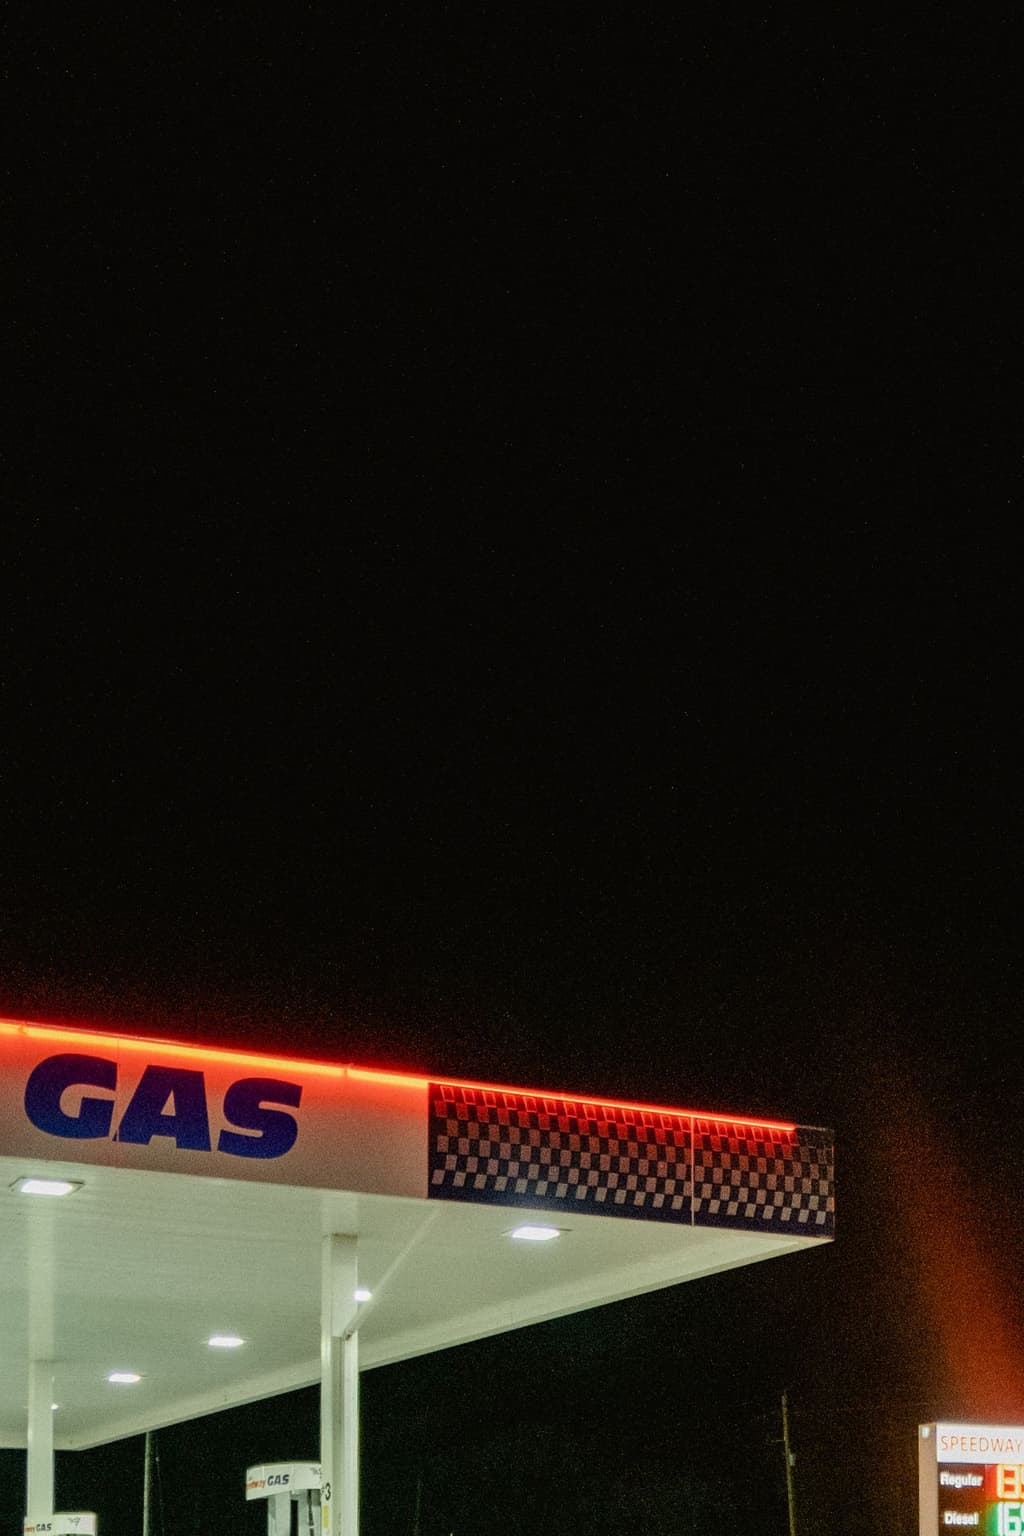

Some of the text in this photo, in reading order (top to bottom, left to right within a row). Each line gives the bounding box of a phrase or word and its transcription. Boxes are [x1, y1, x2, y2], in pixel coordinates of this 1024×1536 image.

[24, 1053, 303, 1160] GAS
[940, 1435, 1022, 1453] SPEEDWAY
[267, 1474, 290, 1487] GAS
[940, 1471, 983, 1488] Regular
[944, 1511, 979, 1525] Diesel
